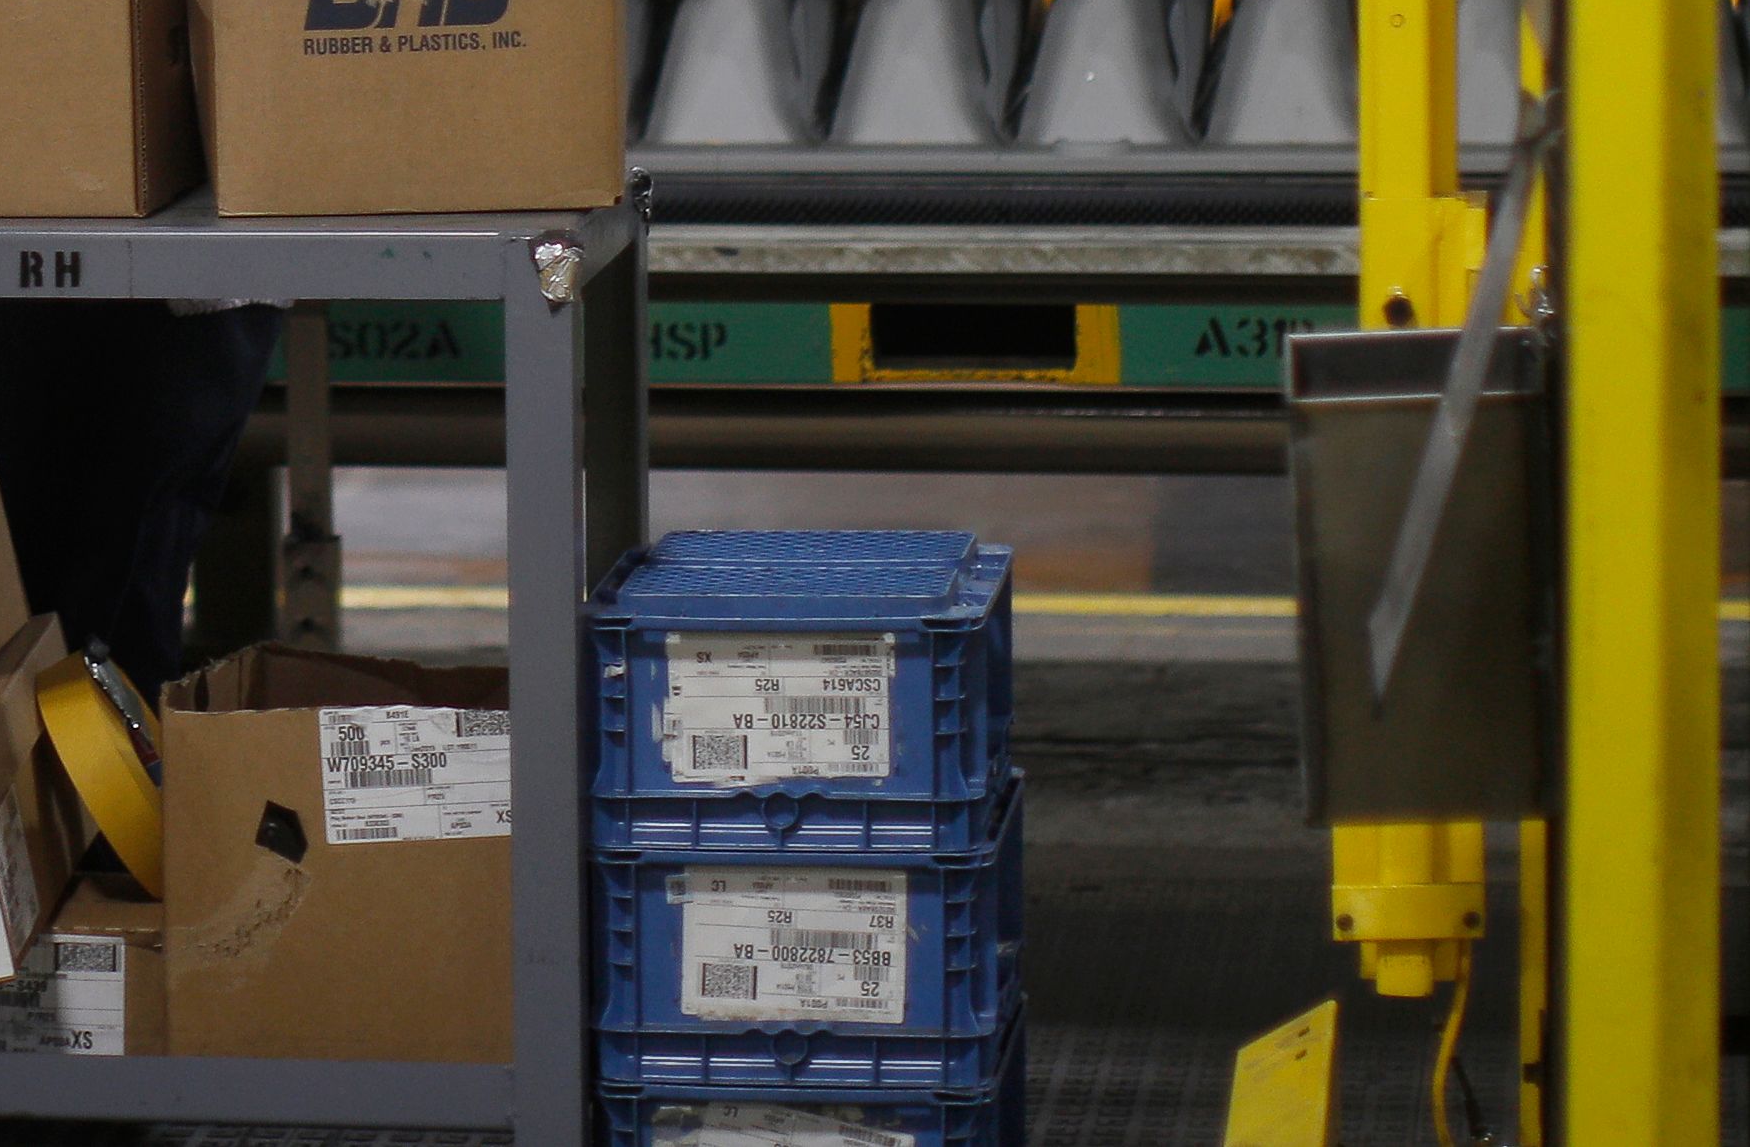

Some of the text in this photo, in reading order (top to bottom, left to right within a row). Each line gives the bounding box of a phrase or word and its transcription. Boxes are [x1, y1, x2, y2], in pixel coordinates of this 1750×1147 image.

[303, 30, 528, 55] RUBBER & PLASTICS, INC.
[18, 249, 81, 288] RH
[755, 678, 780, 692] R25
[822, 678, 882, 692] CSCA614
[733, 713, 754, 730] BA
[771, 713, 827, 730] S22810
[844, 713, 881, 730] CJ54
[338, 725, 366, 742] 500
[851, 745, 870, 761] 25
[327, 755, 395, 773] W709345
[411, 752, 447, 769] S300
[767, 910, 793, 923] R25
[868, 914, 894, 928] R37
[733, 943, 754, 959] BA
[771, 945, 835, 964] 7822800
[852, 949, 892, 966] BB53
[860, 981, 880, 997] 25
[72, 1031, 94, 1050] XS
